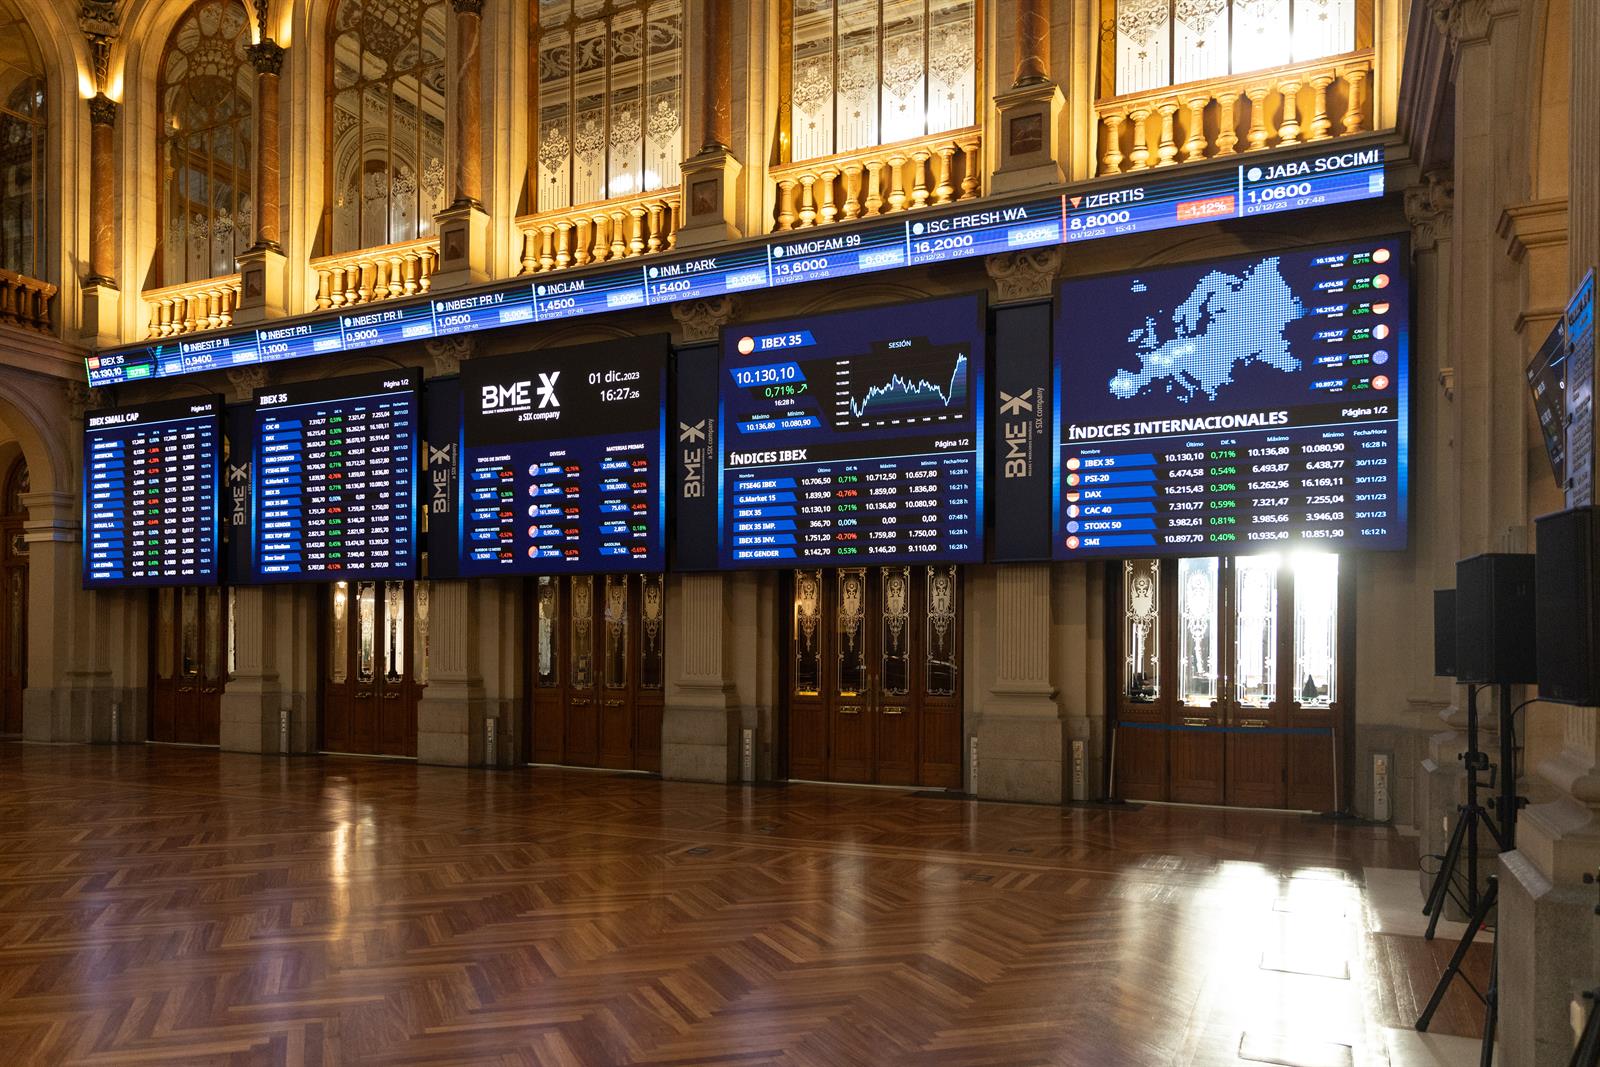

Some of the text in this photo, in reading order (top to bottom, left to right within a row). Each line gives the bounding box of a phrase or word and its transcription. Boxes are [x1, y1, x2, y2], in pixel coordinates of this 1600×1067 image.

[1265, 150, 1379, 179] JABA SOCIMI
[1086, 188, 1145, 208] IZERTIS
[1248, 183, 1312, 203] 1,0600
[1184, 201, 1226, 215] -1,12%
[1247, 201, 1287, 213] 01/12/23
[927, 208, 1027, 234] ISC FRESH WA
[1070, 212, 1130, 231] 8,8000
[786, 235, 861, 257] INMOFAM 99
[914, 236, 973, 253] 16,2000
[661, 259, 716, 276] INM. PARK
[775, 259, 827, 275] 13,6000
[547, 280, 585, 294] INCLAM
[651, 280, 690, 295] 1,5400
[446, 294, 504, 311] INBEST PR IV
[539, 299, 575, 311] 1,4500
[353, 315, 382, 326] INBEST
[384, 312, 396, 321] PR
[438, 315, 470, 327] 1,0500
[268, 328, 295, 340] INBEST
[296, 326, 307, 336] PR
[347, 329, 378, 341] 0,9000
[190, 342, 214, 351] INBEST
[215, 340, 221, 348] P
[262, 344, 288, 353] 1,1000
[761, 334, 802, 349] IBEX 35
[888, 340, 911, 349] SESIÓN
[101, 356, 124, 366] IBEX 35
[185, 355, 212, 365] 0,9400
[90, 368, 121, 378] 10.130,10
[589, 373, 601, 384] 01
[737, 367, 795, 384] 10.130,10
[384, 381, 400, 389] Página
[765, 386, 794, 397] 0,71%
[260, 394, 287, 405] IBEX 35
[483, 381, 531, 409] BME
[1036, 387, 1045, 416] company
[89, 413, 139, 426] IBEX SMALL CAP
[523, 412, 532, 421] SIX
[533, 412, 560, 420] company
[1341, 406, 1388, 418] Página 1/2
[746, 418, 811, 431] 10.136,80 10.080,90
[1069, 411, 1288, 440] ÍNDICES INTERNACIONALES
[935, 438, 969, 449] Página 1/2
[1005, 421, 1027, 478] BME
[730, 449, 807, 466] ÍNDICES IBEX
[1084, 458, 1101, 467] IBEX
[1103, 458, 1115, 466] 35
[1164, 452, 1204, 463] 10.130,10
[1210, 449, 1236, 460] 0,71%
[1248, 446, 1289, 457] 10.136,80
[1301, 442, 1344, 454] 10.080,90
[684, 448, 701, 498] BME
[801, 477, 831, 486] 10.706,50
[838, 475, 858, 483] 0,71%
[866, 473, 897, 482] 10.712,50
[905, 470, 937, 479] 10.657,80
[1084, 458, 1387, 483] PSI-20 6.474,58 0,54% 6.493,87 6.438,77 30/11/23
[433, 469, 447, 513] BME
[805, 491, 831, 500] 1.839,90
[836, 489, 858, 497] -0,76%
[869, 487, 897, 495] 1.859,00
[909, 485, 937, 494] 1.836,80
[1084, 475, 1387, 498] DAX 16.215,43 0,30% 16.262,96 16.169,11 30/11/23
[233, 485, 244, 526] BME
[801, 505, 831, 514] 10.130,10
[838, 503, 857, 512] 0,71%
[866, 502, 896, 510] 10.136,80
[905, 499, 937, 508] 10.080,90
[1084, 493, 1387, 515] CAC 40 7.310,77 0,59% 7.321,47 7.255,04 30/11/23
[810, 519, 831, 528] 366,70
[838, 518, 857, 526] 0,00%
[882, 516, 896, 524] 0,00
[922, 514, 937, 523] 0,00
[1084, 511, 1387, 530] STOXX 50 3.982,61 0,81% 3.985,66 3.946,03 30/11/23
[1084, 538, 1100, 546] SMI
[1164, 533, 1204, 545] 10.897,70
[1209, 532, 1236, 543] 0,40%
[1247, 530, 1289, 541] 10.935,40
[1301, 528, 1344, 539] 10.851,90
[1360, 528, 1379, 536] 16:12
